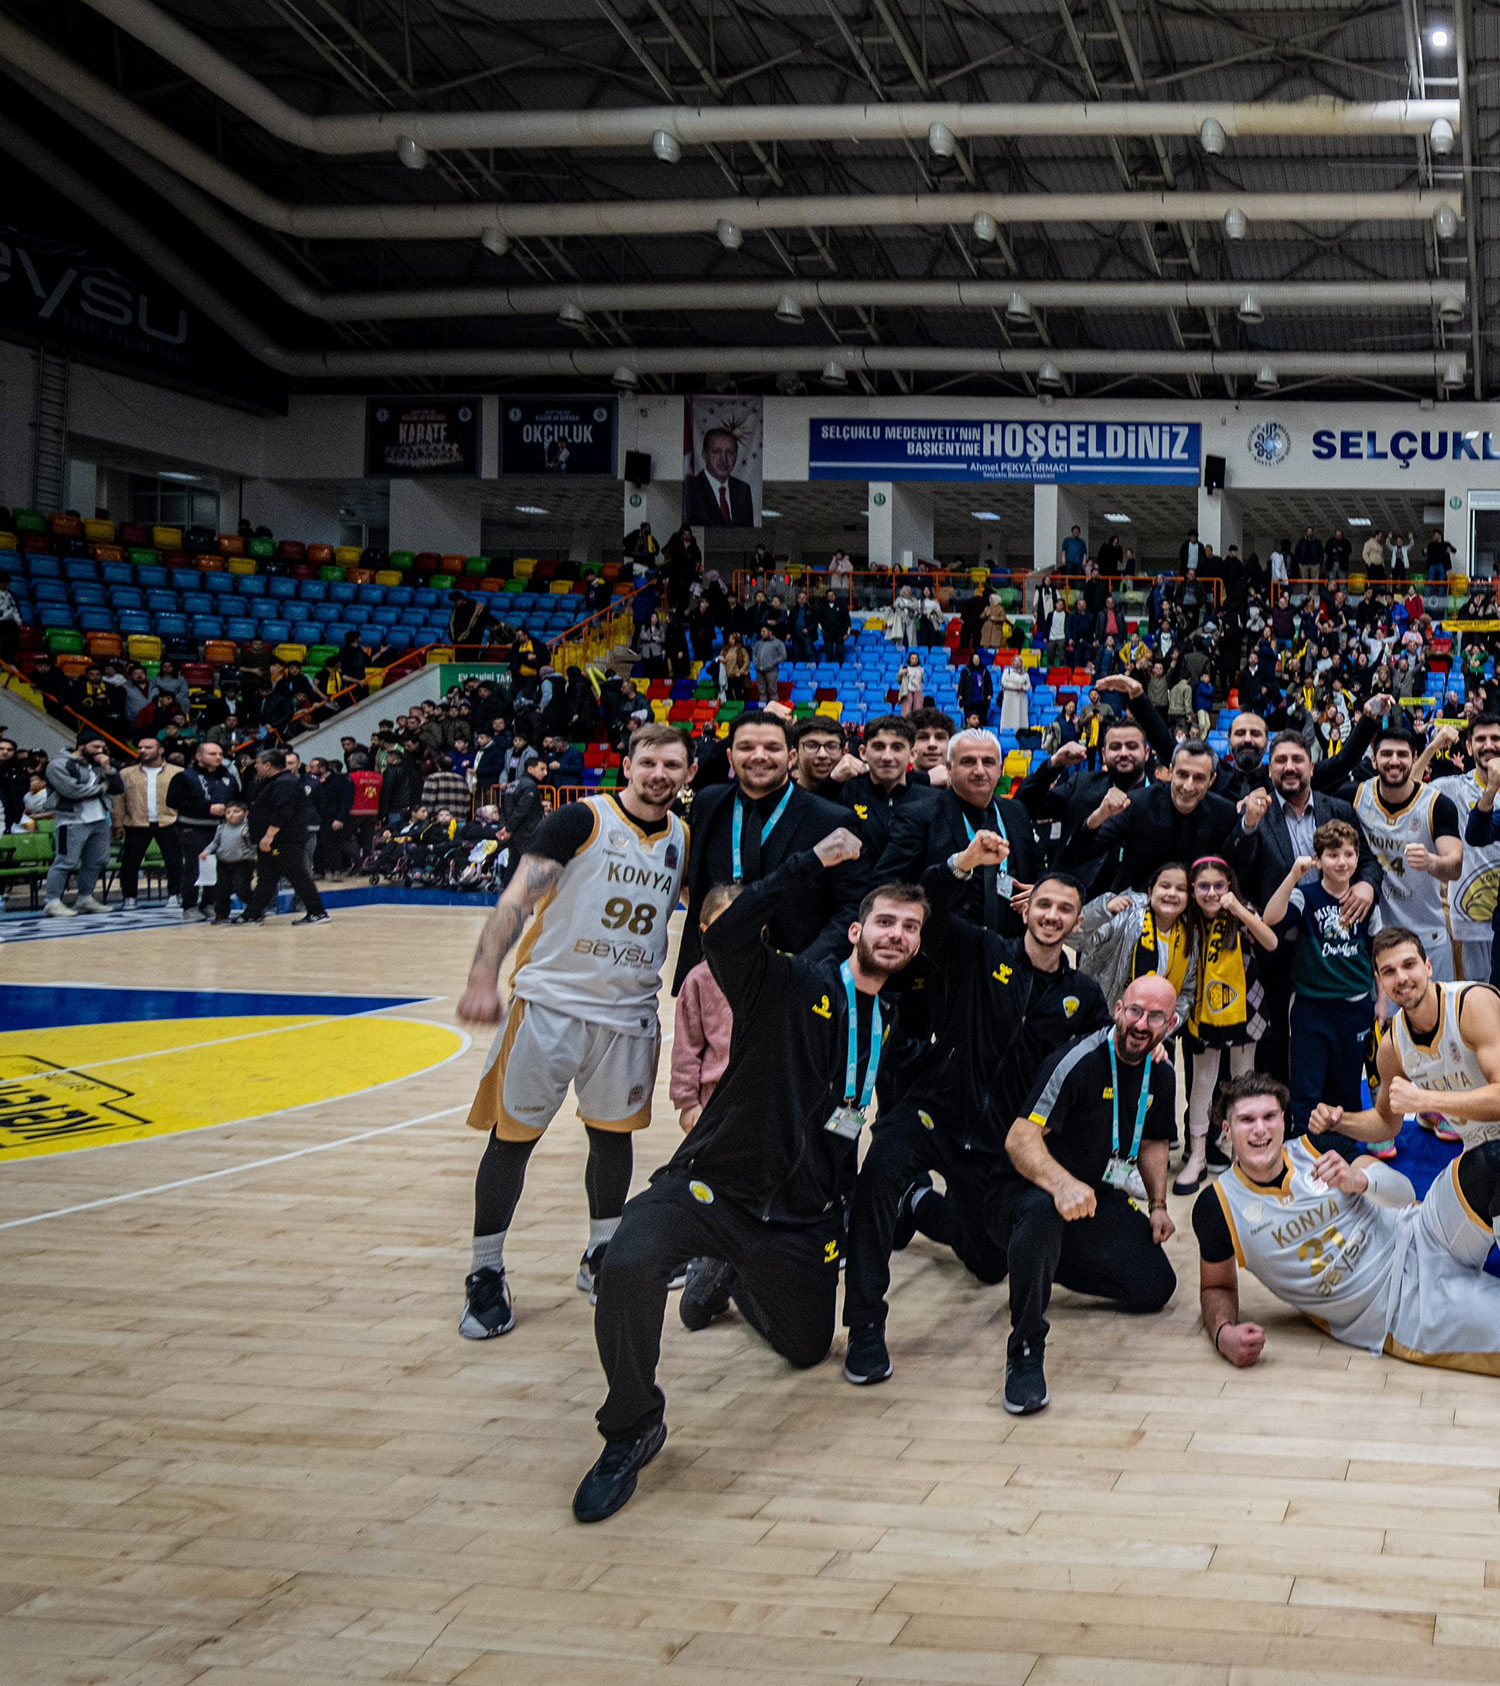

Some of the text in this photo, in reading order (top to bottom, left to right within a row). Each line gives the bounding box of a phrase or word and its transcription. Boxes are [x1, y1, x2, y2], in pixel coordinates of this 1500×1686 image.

[821, 426, 880, 442] SELÇUKLU
[970, 462, 998, 471] Ahmet
[1368, 833, 1403, 852] KONY
[607, 861, 673, 895] KONYA
[600, 896, 657, 935] 98
[1271, 1197, 1340, 1249] KONYA
